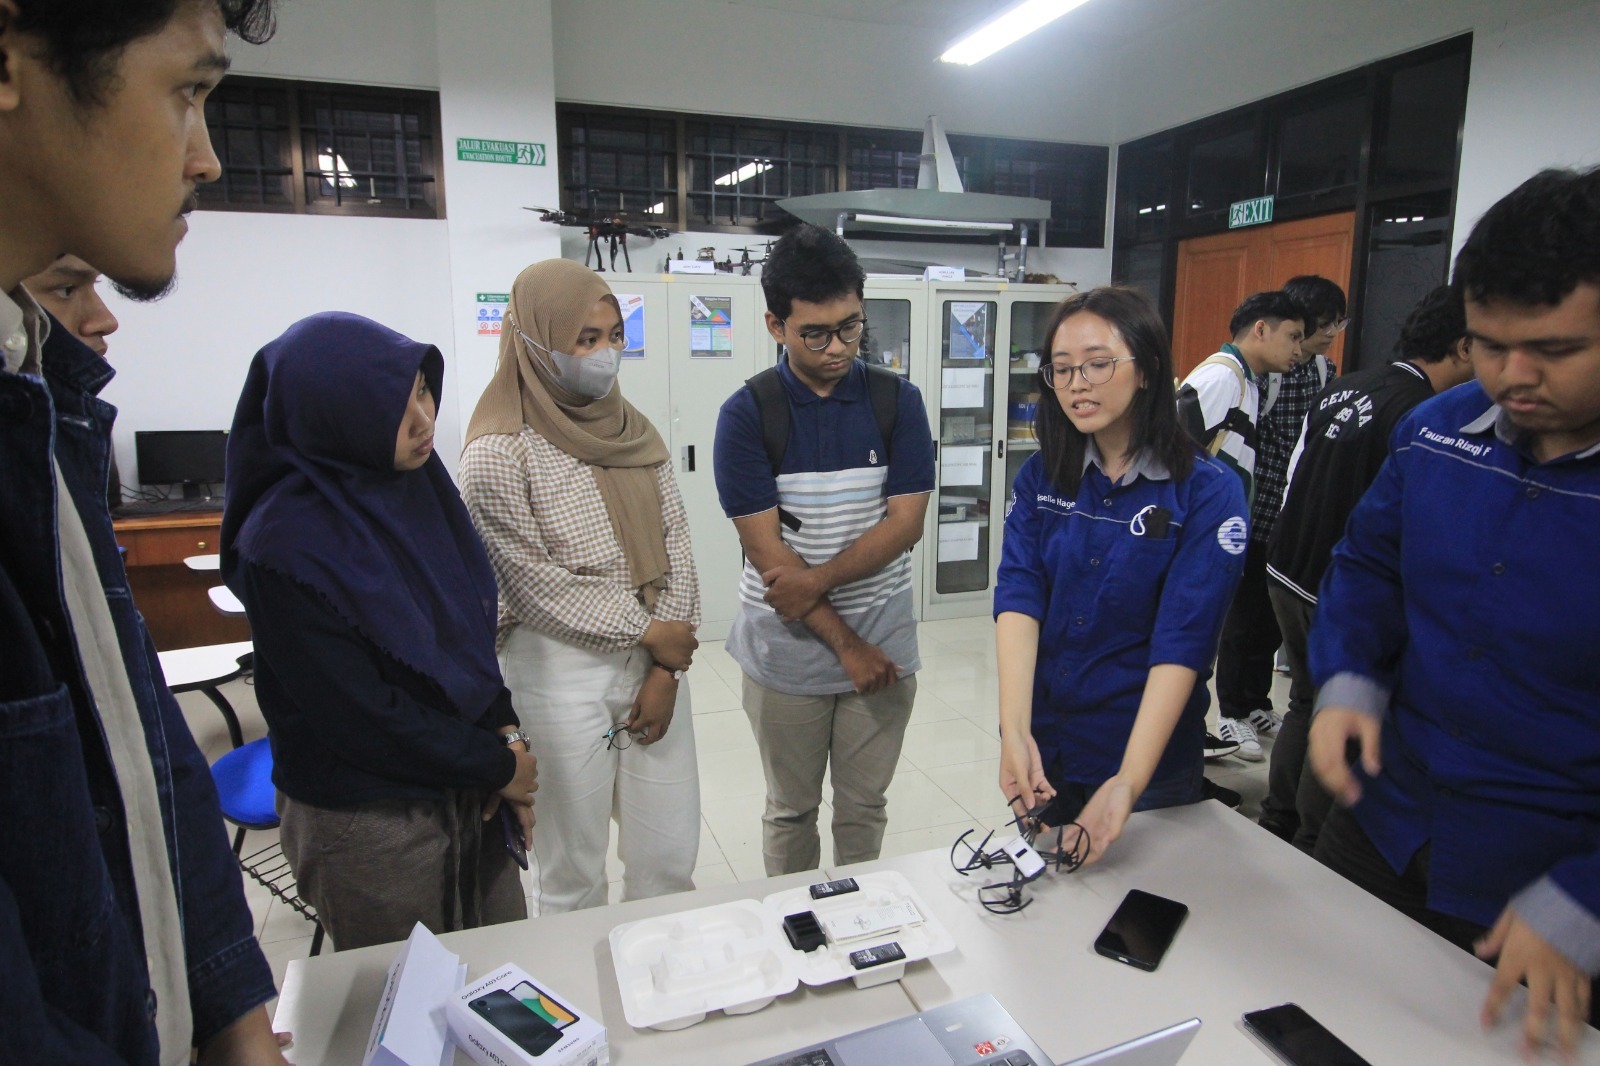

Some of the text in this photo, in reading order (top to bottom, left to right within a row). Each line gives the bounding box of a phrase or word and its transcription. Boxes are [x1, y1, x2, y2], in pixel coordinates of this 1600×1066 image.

[459, 140, 515, 153] JALUR EVAKUASI
[462, 152, 513, 163] EVACUATION ROUTE
[1243, 197, 1272, 224] EXIT
[1419, 426, 1492, 457] Fauzan Rizqi F
[1056, 497, 1076, 509] Hage
[461, 971, 513, 1000] Galaxy A03 Core
